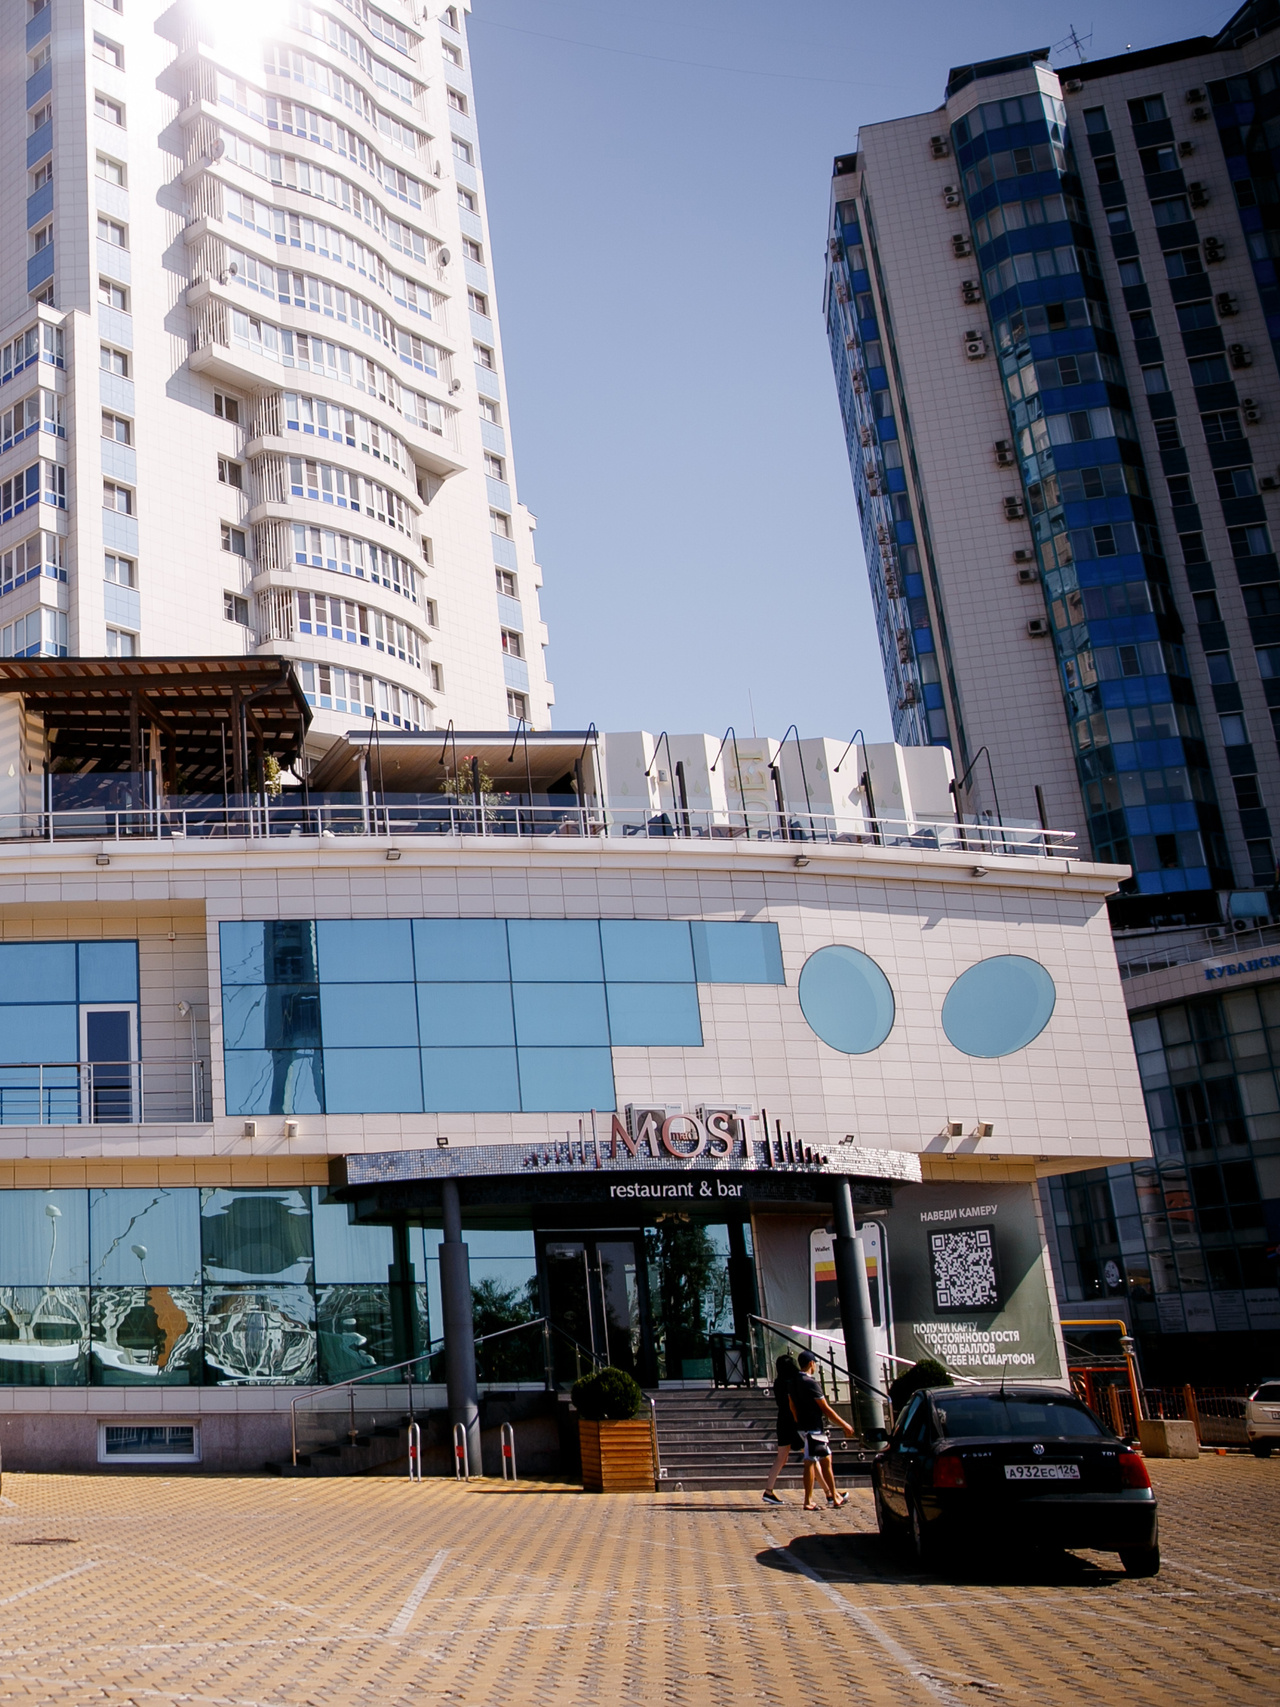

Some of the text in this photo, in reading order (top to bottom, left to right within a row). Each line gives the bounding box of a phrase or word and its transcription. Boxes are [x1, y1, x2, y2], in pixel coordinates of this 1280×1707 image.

[611, 1112, 760, 1158] MOST
[610, 1179, 743, 1198] restaurant & bar
[920, 1204, 998, 1222] НАВЕДИ КАМЕРУ
[913, 1322, 978, 1334] ПОЛУЧИ КАРТУ
[924, 1330, 1020, 1344] ПОСТОЯННОГО ГОСТЯ
[942, 1343, 958, 1355] 500
[959, 1343, 996, 1354] БАЛЛОВ
[946, 1352, 1036, 1366] СЕБЕ НА СМАРТФОН
[1008, 1465, 1076, 1479] А932ЕС 126
